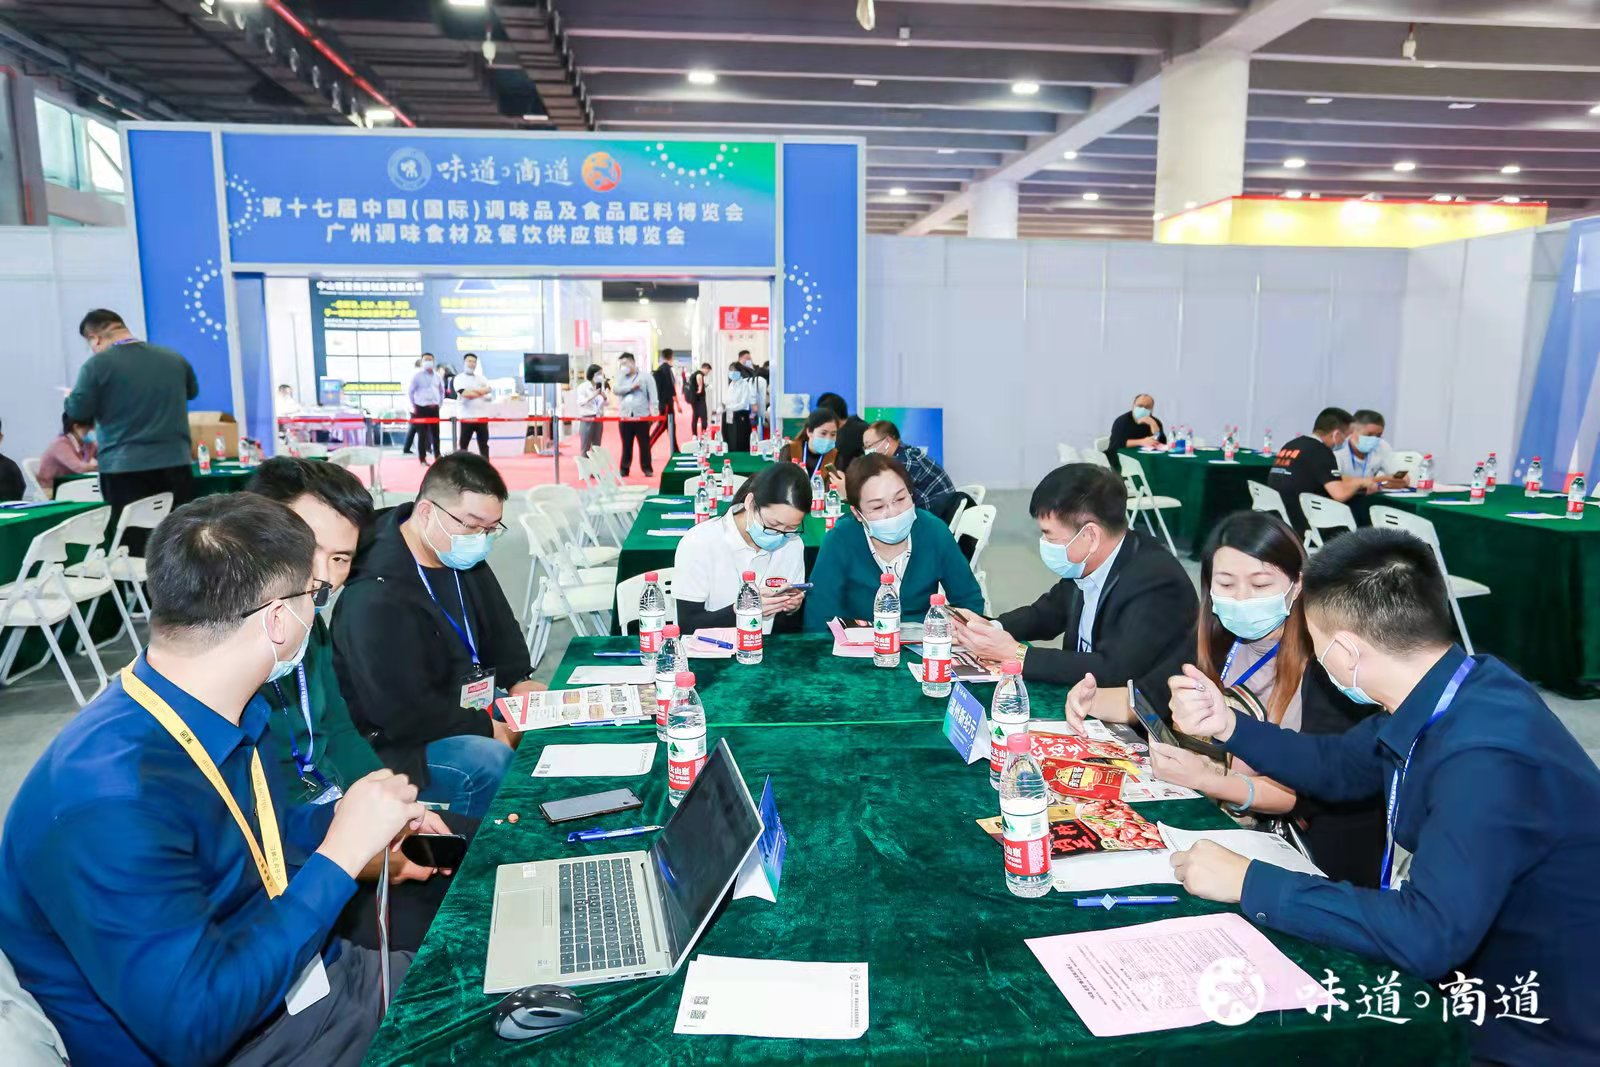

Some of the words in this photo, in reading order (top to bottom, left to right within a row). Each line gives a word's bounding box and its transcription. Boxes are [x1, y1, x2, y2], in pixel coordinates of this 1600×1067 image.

[262, 196, 744, 223] 第十七届中国(国际)调味品及食品配料博览会
[326, 223, 686, 246] 广州调味食材及餐饮供应链博览会
